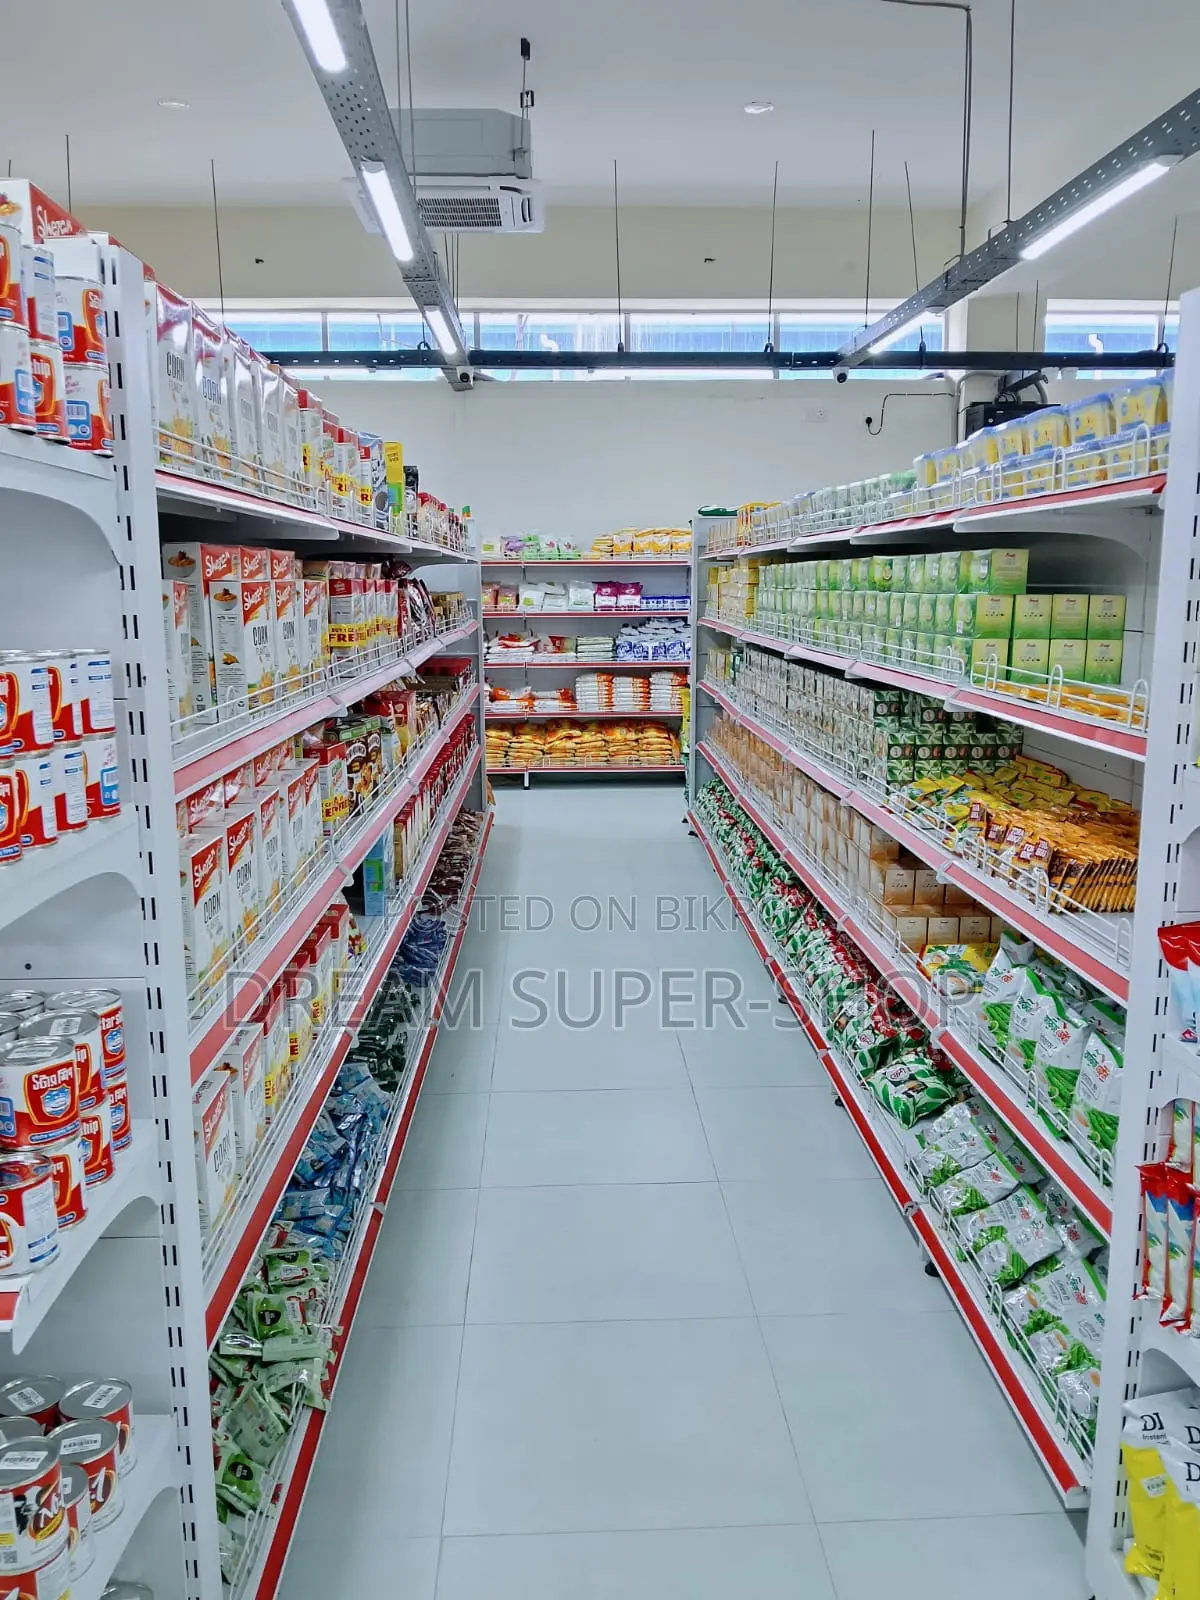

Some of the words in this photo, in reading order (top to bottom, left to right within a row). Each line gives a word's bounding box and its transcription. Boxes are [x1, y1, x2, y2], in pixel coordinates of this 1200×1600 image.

[166, 351, 185, 382] CORN
[202, 376, 222, 405] CORN
[252, 625, 269, 647] CORN
[236, 860, 252, 890] CORN
[203, 890, 221, 924] CORN
[213, 1128, 230, 1173] CORN
